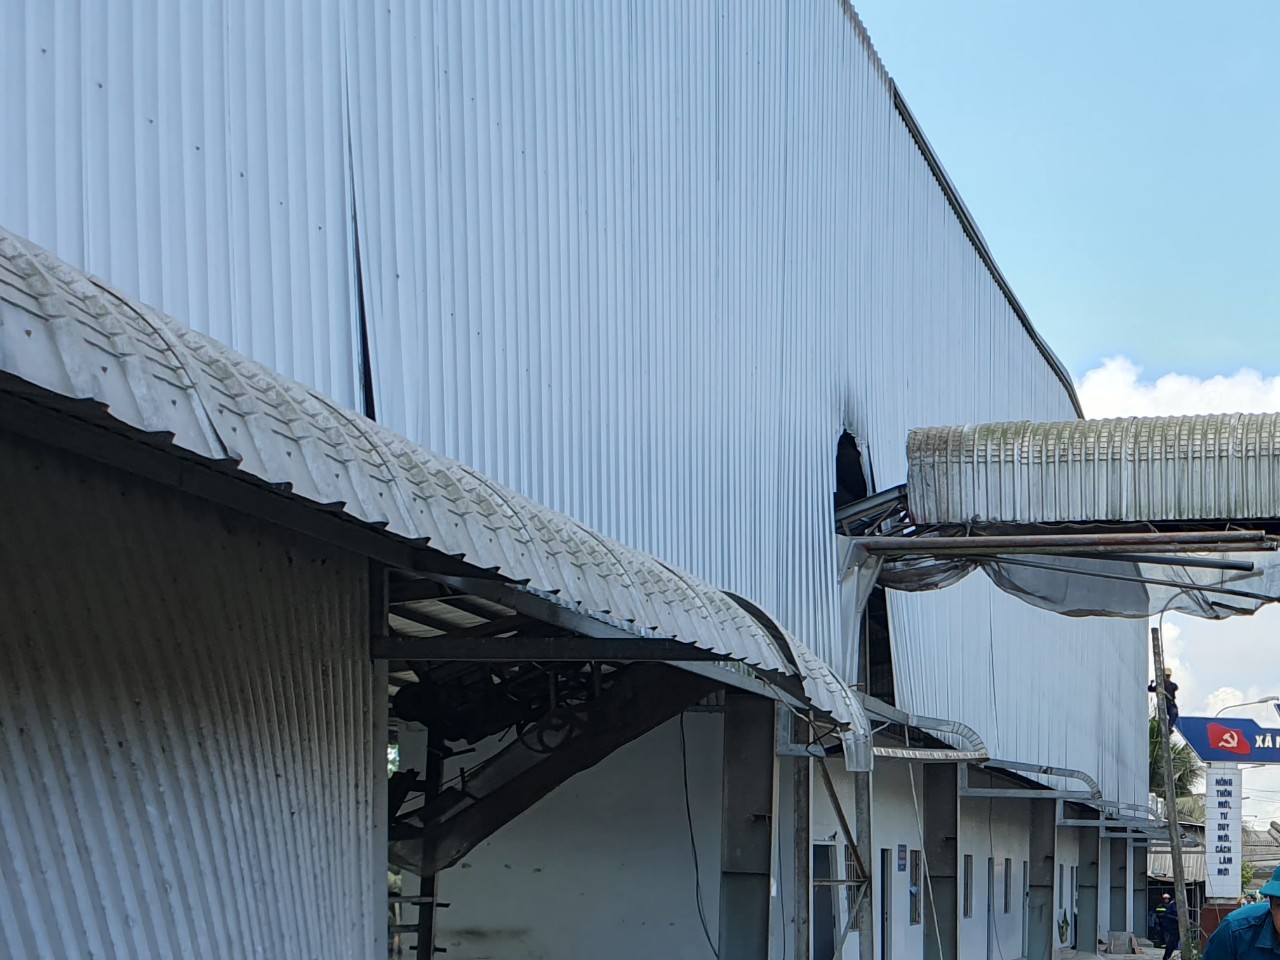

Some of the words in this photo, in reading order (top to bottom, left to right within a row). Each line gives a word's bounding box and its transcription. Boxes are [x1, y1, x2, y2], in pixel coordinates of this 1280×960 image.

[1255, 733, 1273, 748] XÃ
[1215, 778, 1232, 786] NÔNG
[1216, 788, 1232, 798] THÔN
[1217, 823, 1230, 831] DUY
[1215, 844, 1231, 854] CÁCH
[1219, 856, 1232, 865] LÀM
